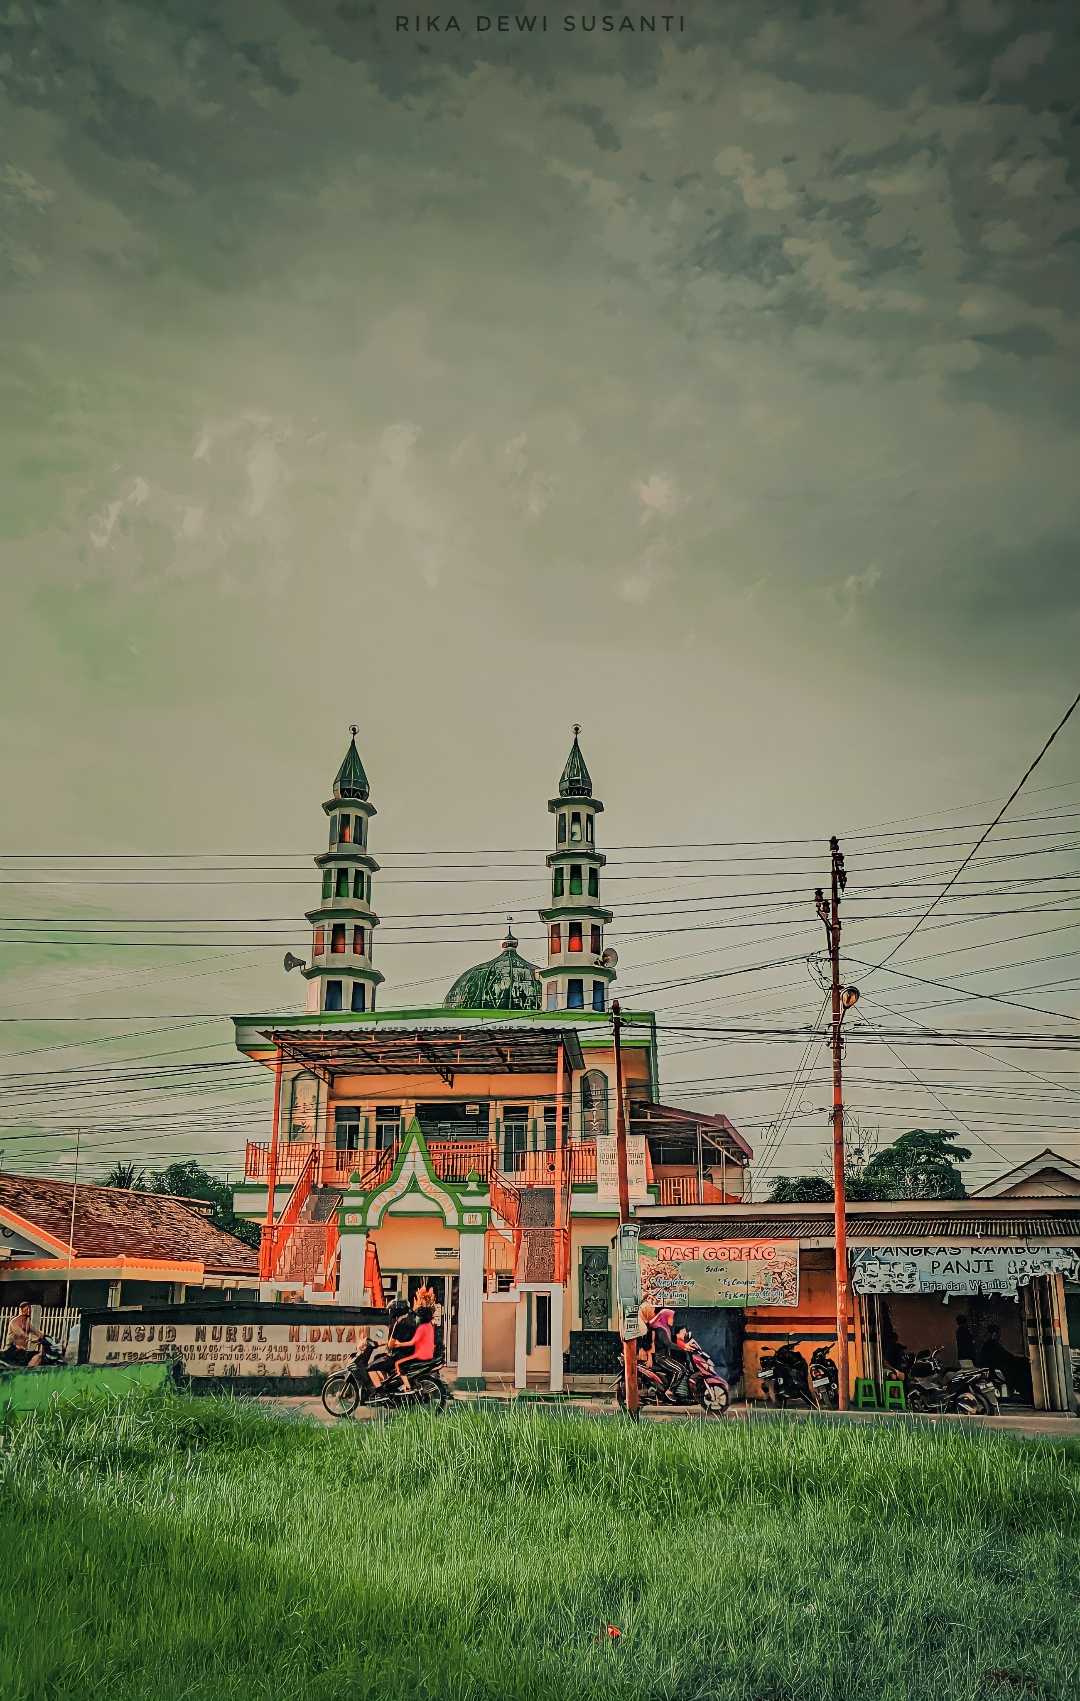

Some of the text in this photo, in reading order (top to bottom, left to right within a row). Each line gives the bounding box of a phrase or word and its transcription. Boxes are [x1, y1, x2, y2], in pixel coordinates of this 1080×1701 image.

[703, 1246, 777, 1261] GORENG
[870, 1247, 962, 1257] PANGKAS
[931, 1260, 994, 1274] PANJI
[921, 1279, 1009, 1292] Pria dan Wanita
[106, 1325, 177, 1342] MASJID
[194, 1325, 267, 1342] NURUL
